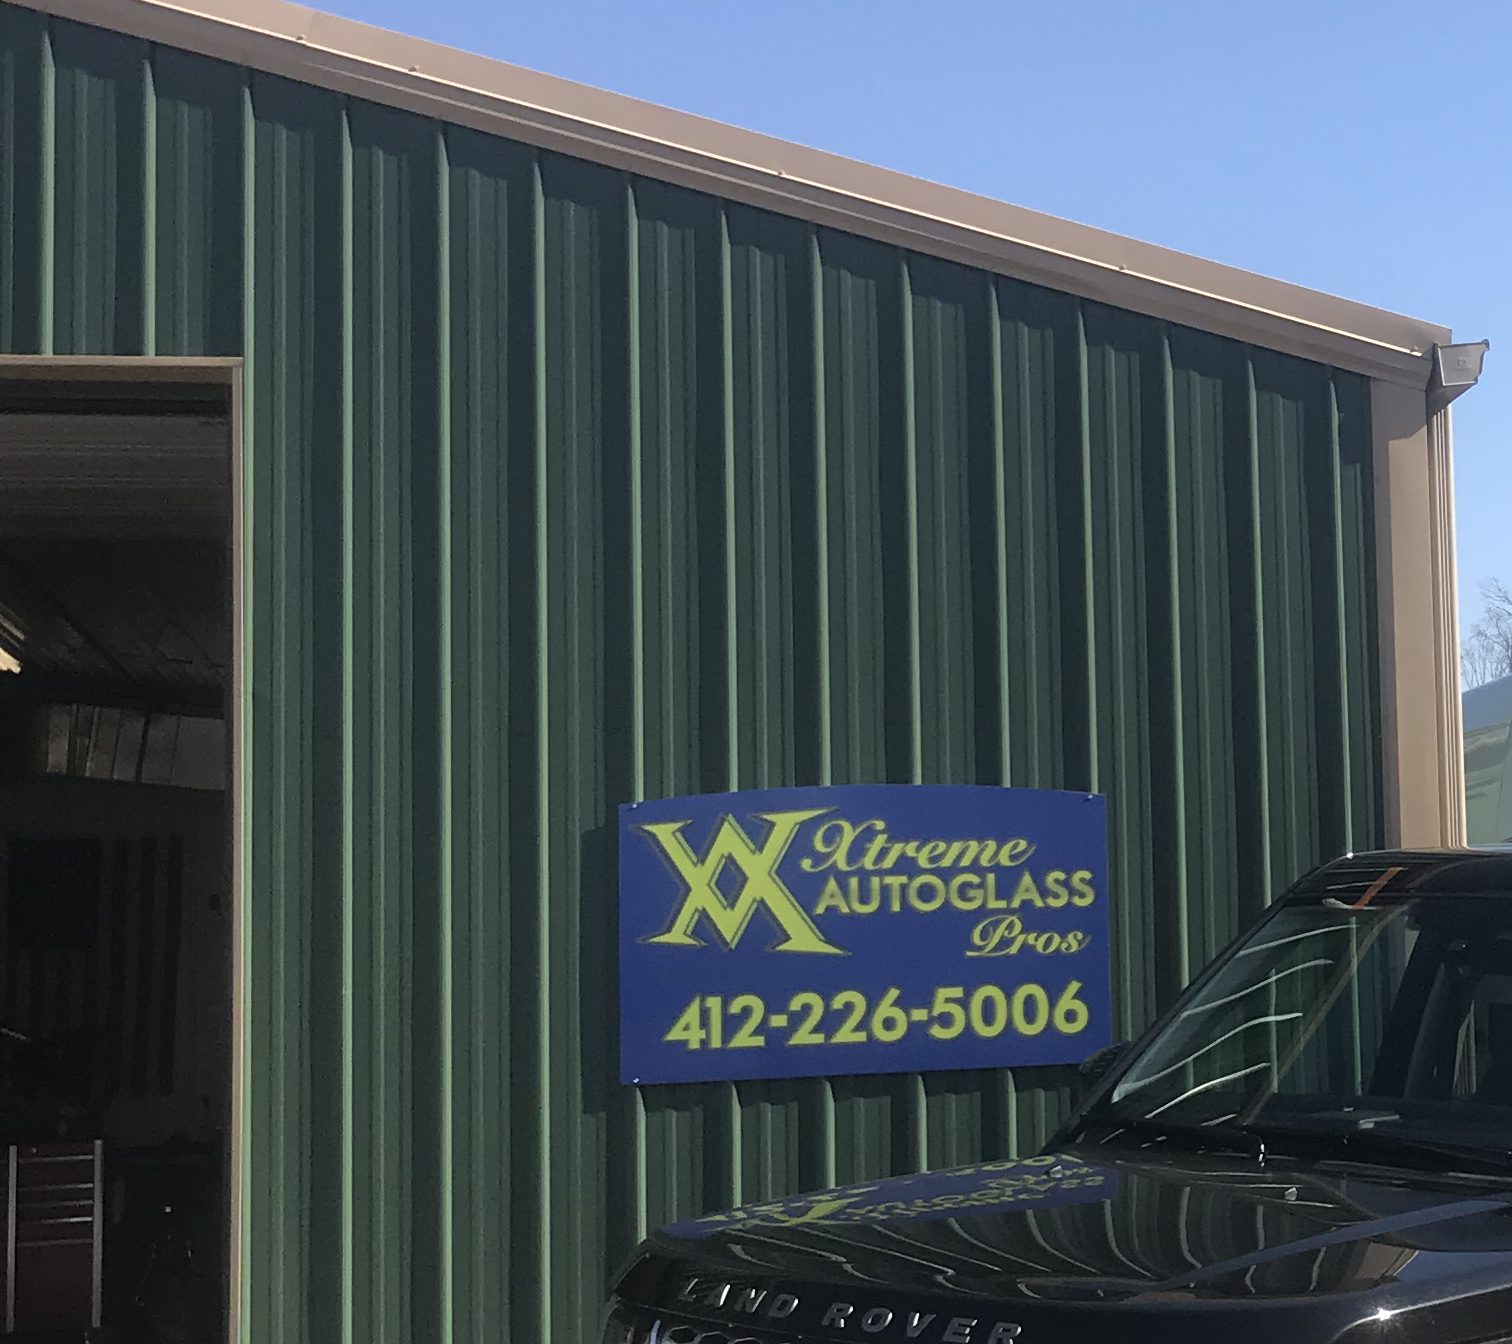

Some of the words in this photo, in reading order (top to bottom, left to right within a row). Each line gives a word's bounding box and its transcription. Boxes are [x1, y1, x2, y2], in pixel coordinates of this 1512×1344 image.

[801, 818, 1036, 873] Xtreme
[814, 870, 1096, 916] AUTOGLASS
[965, 913, 1089, 958] Pros
[662, 979, 1090, 1052] 412-226-5006
[679, 1277, 799, 1319] LAND
